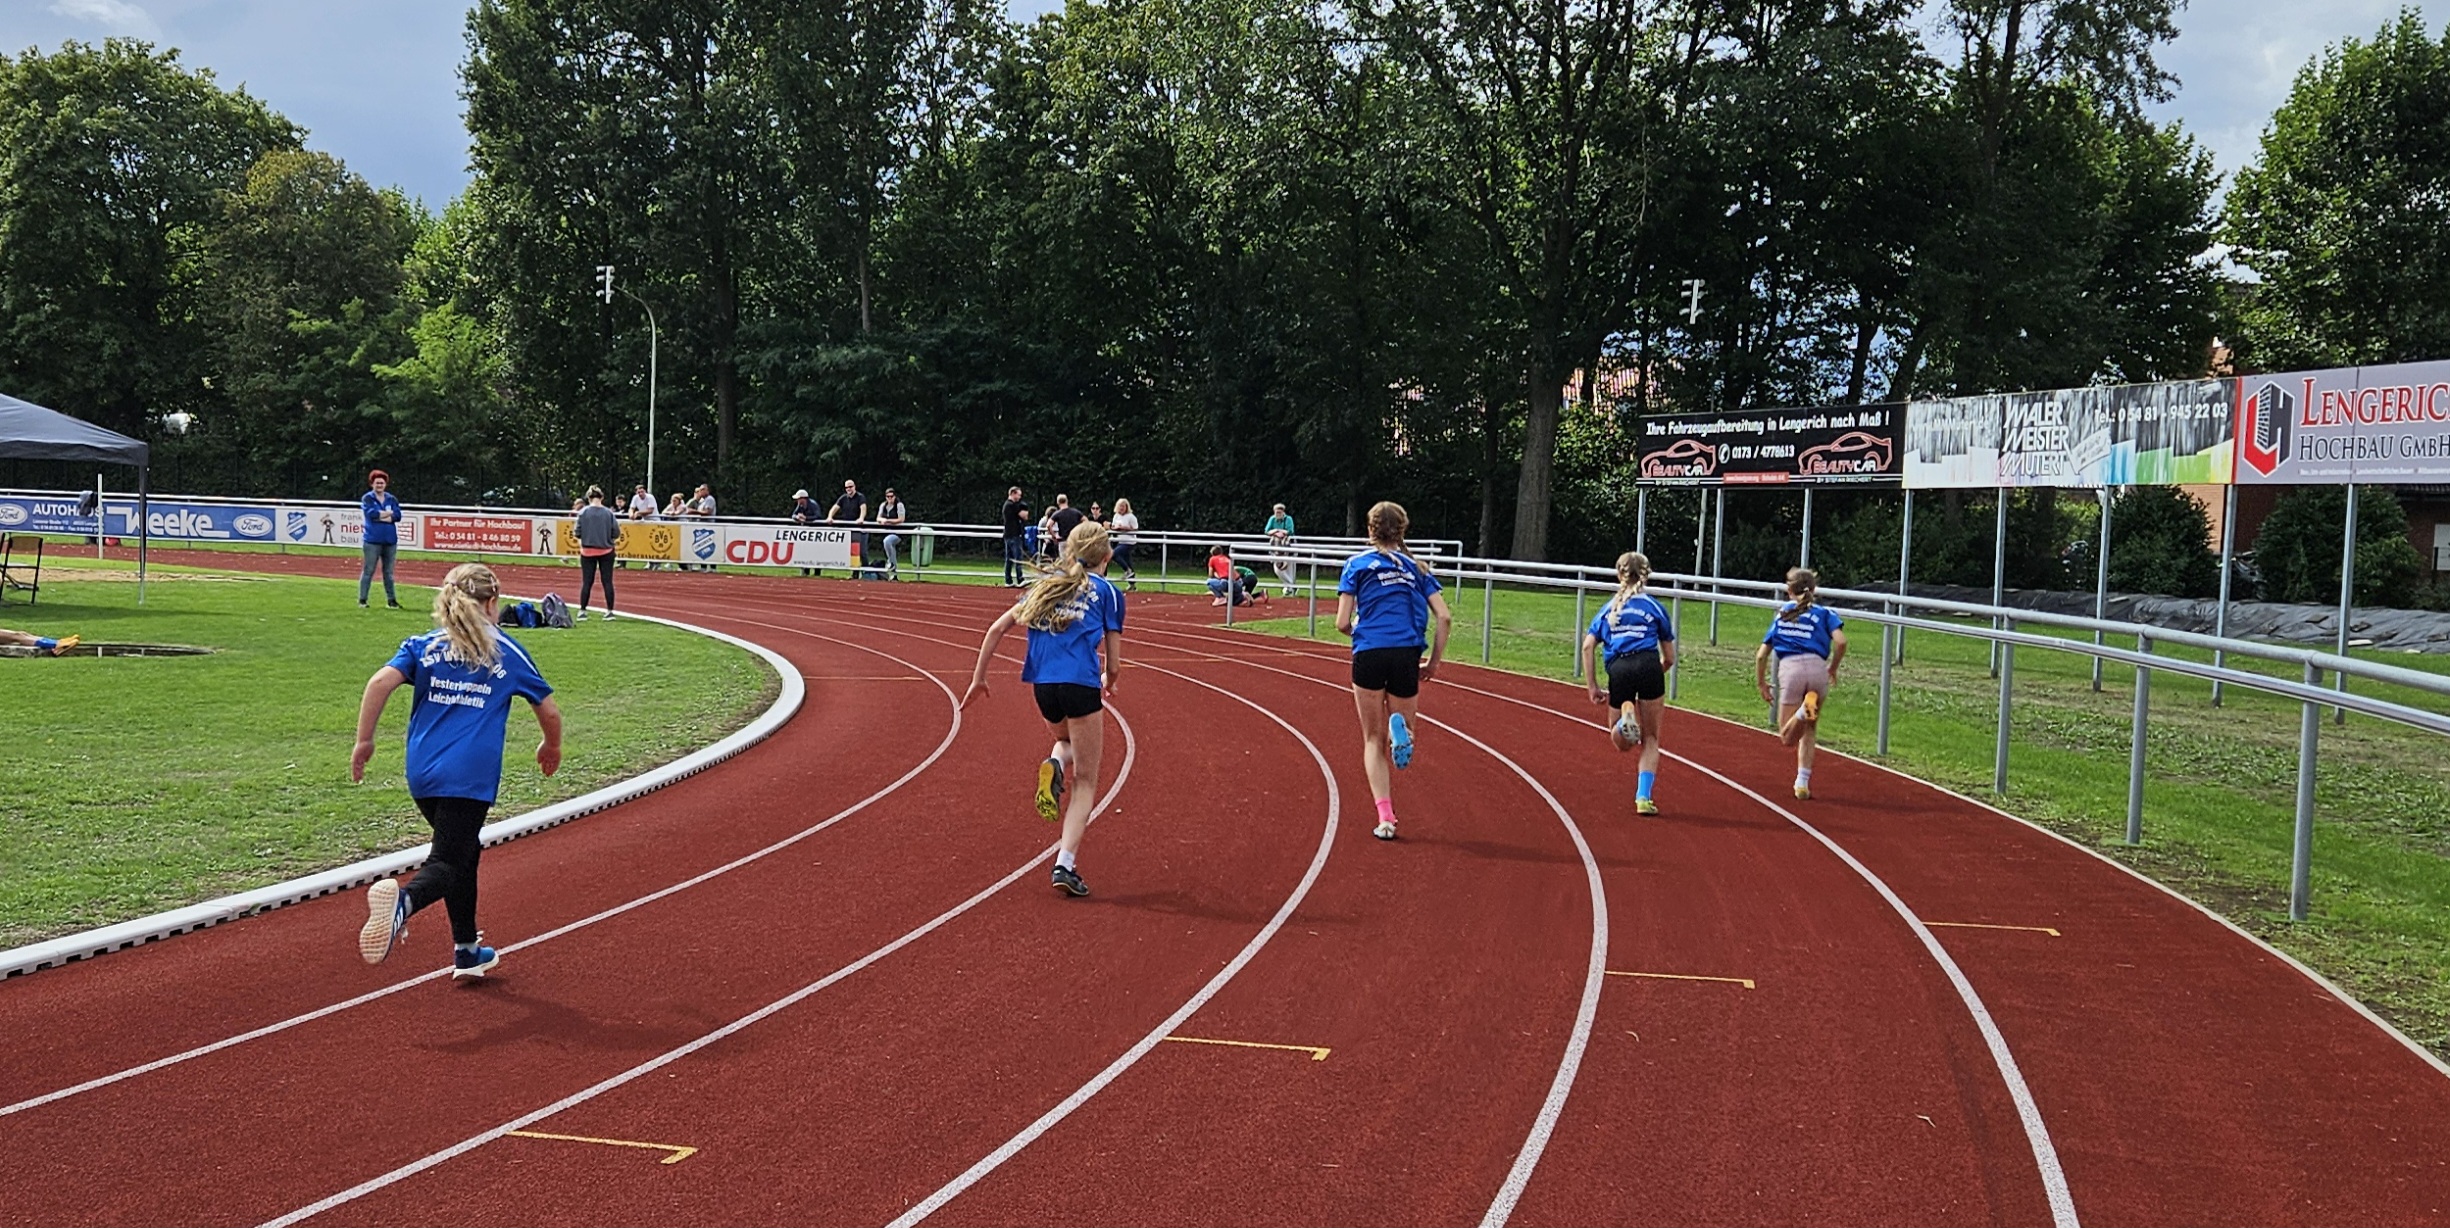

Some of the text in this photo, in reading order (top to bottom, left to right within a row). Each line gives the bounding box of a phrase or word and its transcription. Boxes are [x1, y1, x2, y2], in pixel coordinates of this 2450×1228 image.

[2095, 408, 2116, 423] Tel.:
[2118, 408, 2125, 422] 0
[2128, 408, 2141, 422] 54
[2144, 407, 2157, 421] 81
[2170, 405, 2191, 419] 945
[2194, 404, 2210, 418] 22
[2213, 402, 2228, 417] 03
[2301, 378, 2450, 426] LENGERIC
[1646, 422, 1666, 435] Ihre
[1668, 418, 1764, 437] Fahrzeugaufbereitung
[1767, 417, 1777, 431] in
[1779, 414, 1827, 433] Lengerich
[1830, 412, 1855, 428] nach
[1859, 411, 1882, 427] Maß
[2003, 401, 2063, 428] MALER
[2002, 426, 2069, 452] MEISTER
[2299, 435, 2394, 460] HOCHBAU
[1732, 446, 1751, 459] 0173
[2000, 452, 2068, 476] MUTERT
[241, 518, 264, 531] Ford
[430, 518, 525, 529] Ihr Partner für Hochbau!
[449, 532, 455, 540] 0
[467, 533, 475, 541] 81
[776, 530, 845, 543] LENGERICH
[726, 539, 794, 565] CDU
